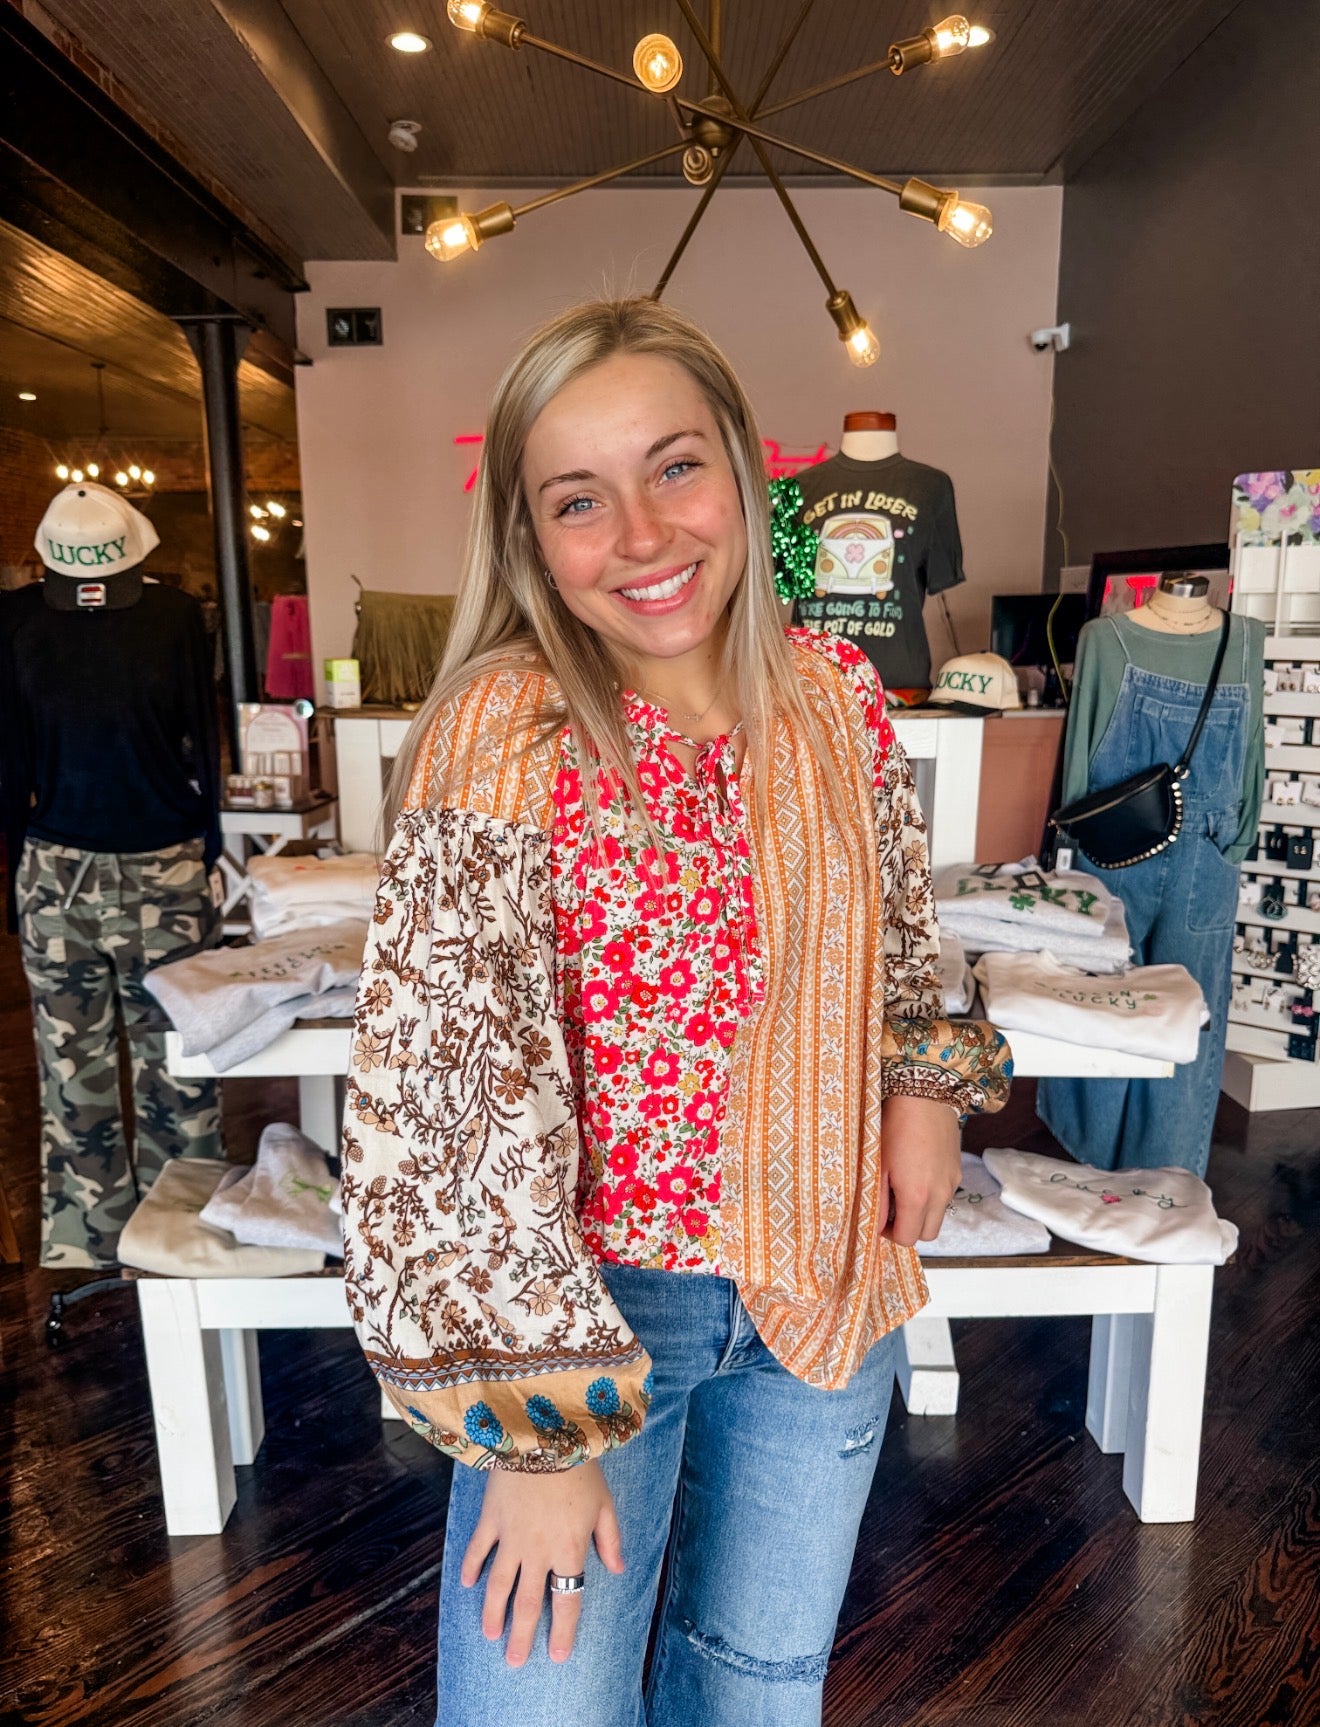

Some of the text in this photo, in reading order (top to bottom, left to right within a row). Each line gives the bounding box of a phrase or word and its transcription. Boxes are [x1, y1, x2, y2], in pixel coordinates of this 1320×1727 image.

[803, 490, 918, 525] GET IN LOSER
[48, 535, 126, 566] LUCKY
[825, 600, 866, 618] GOING
[868, 602, 881, 618] TO
[823, 617, 848, 635] POT
[847, 620, 864, 636] OF
[864, 621, 896, 638] GOLD
[935, 671, 993, 695] UCKY
